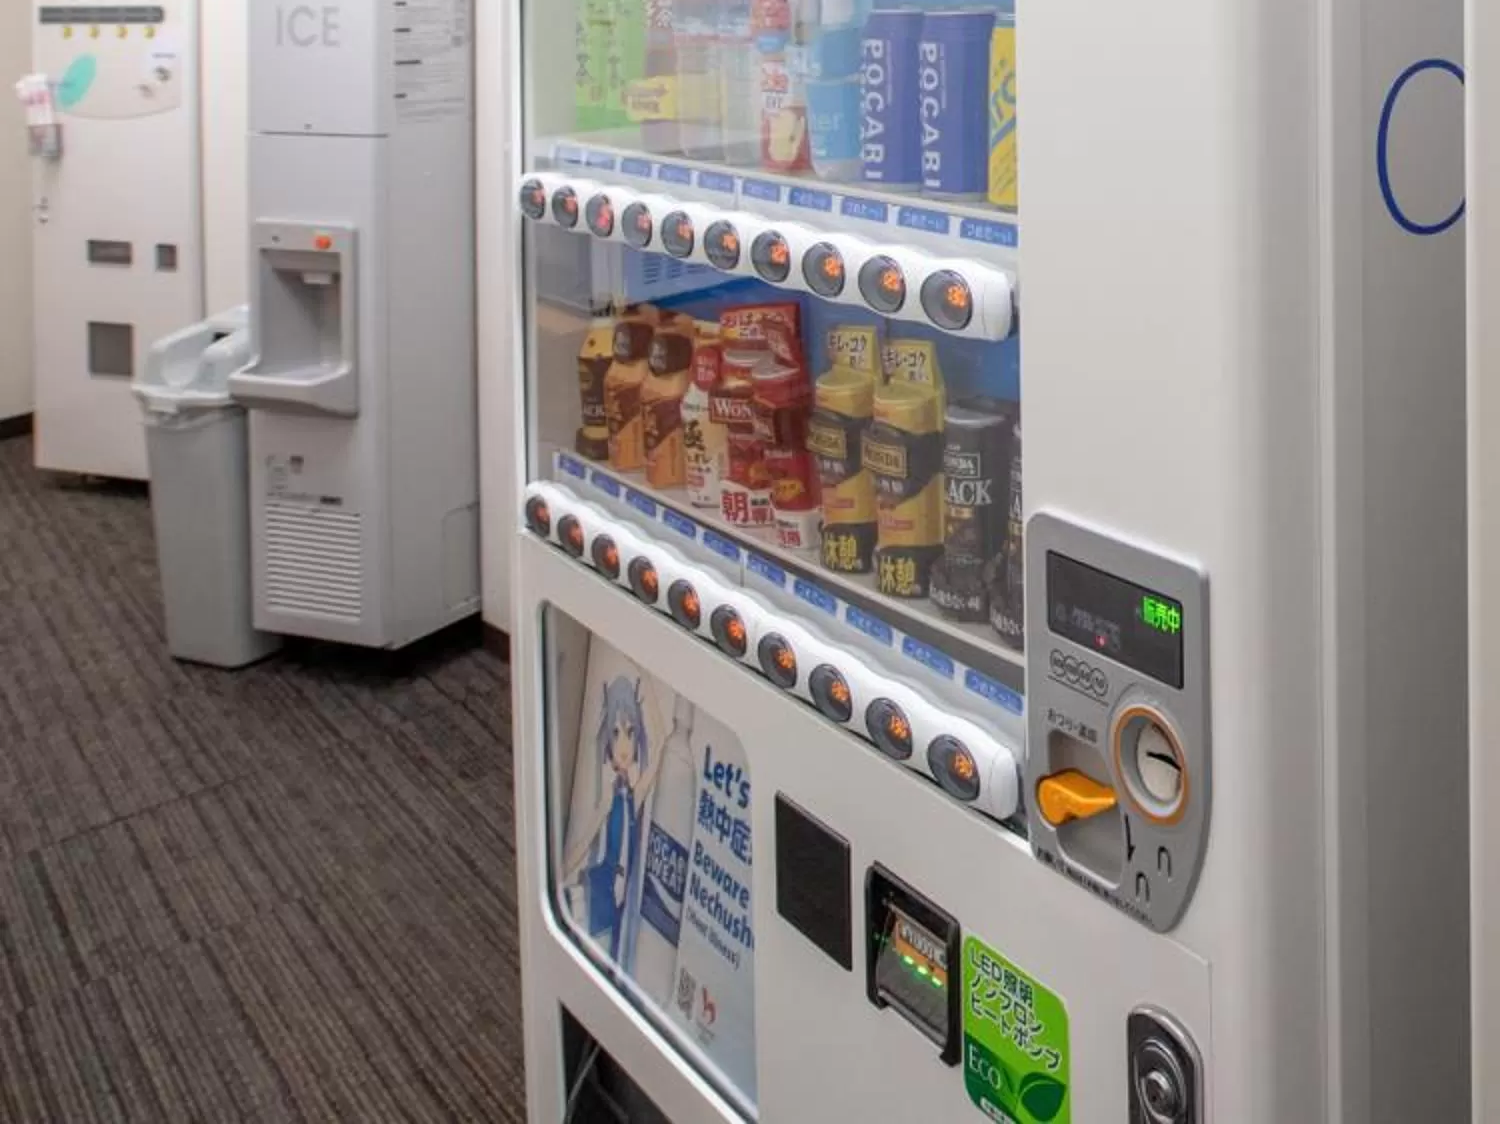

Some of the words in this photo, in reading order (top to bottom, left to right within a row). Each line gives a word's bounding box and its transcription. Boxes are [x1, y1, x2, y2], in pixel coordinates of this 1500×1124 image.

[274, 5, 341, 47] ICE
[864, 38, 885, 179] POCARI
[920, 42, 942, 189] POCARI
[703, 743, 751, 810] Let's
[693, 838, 750, 910] Beware
